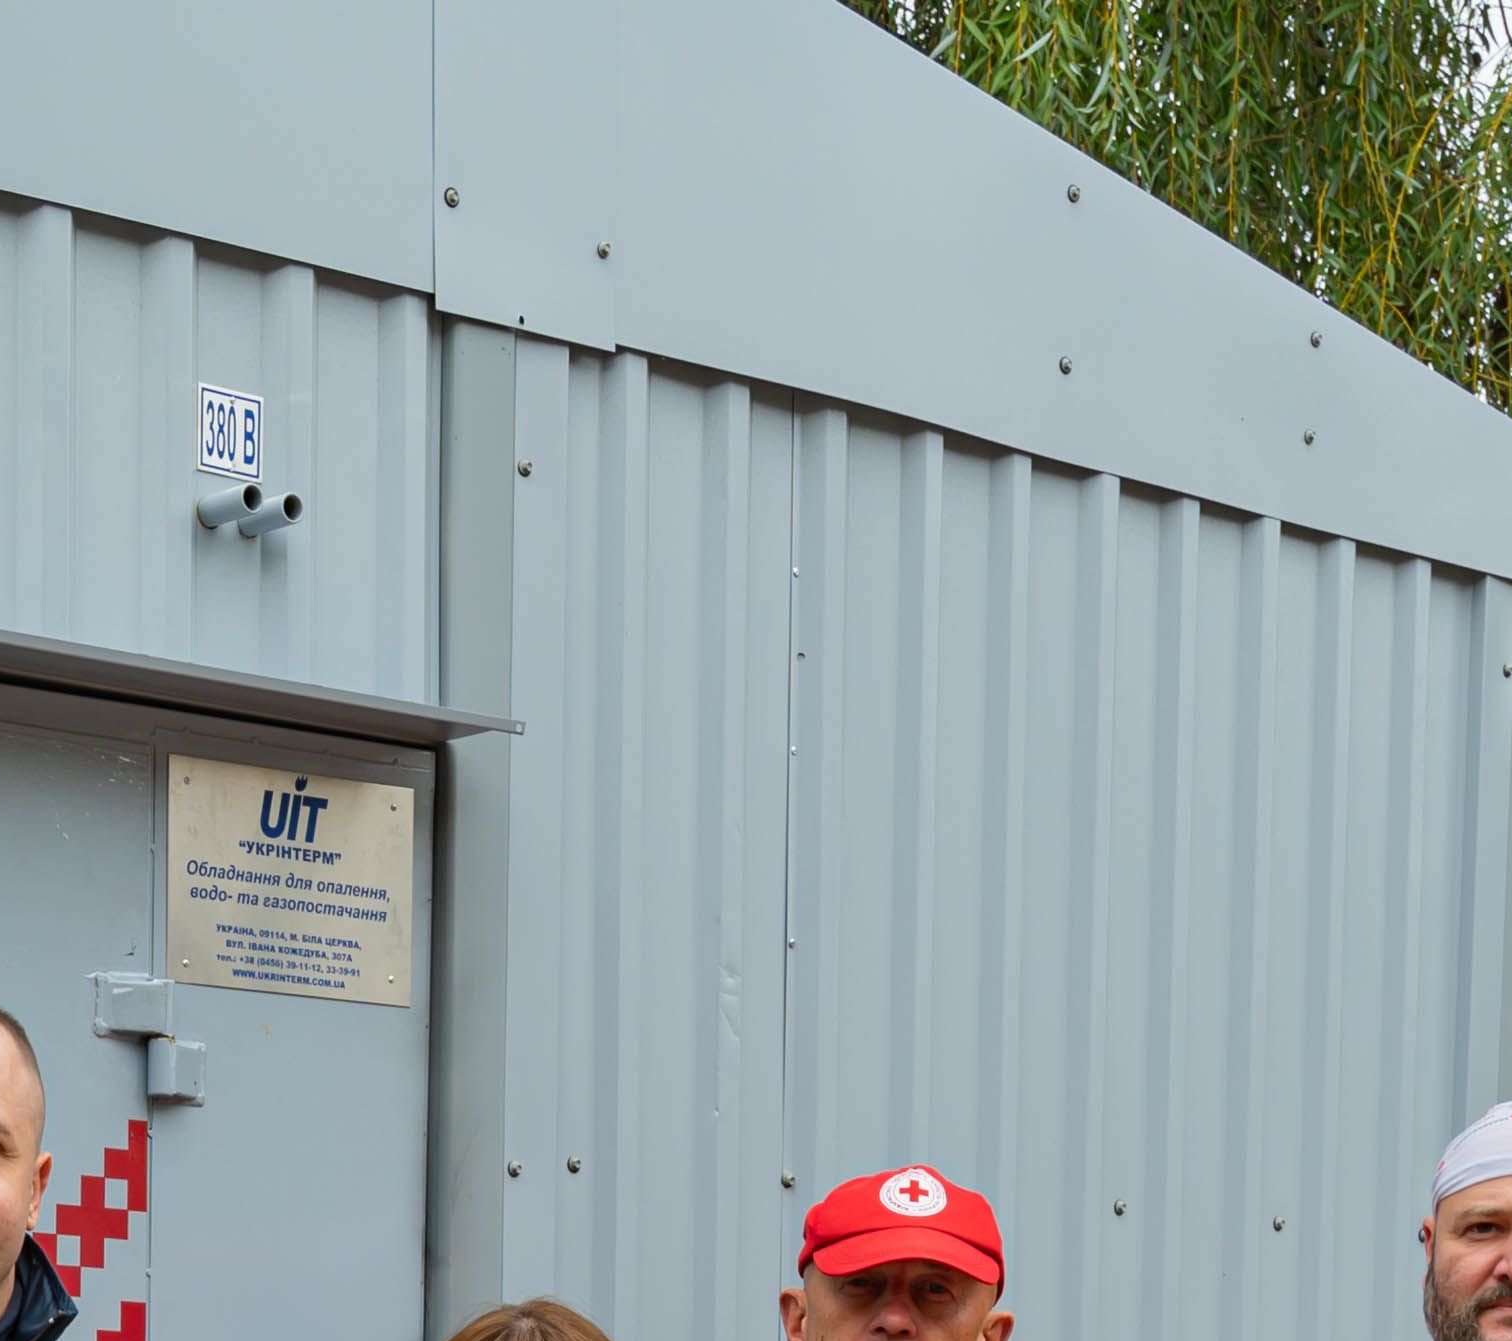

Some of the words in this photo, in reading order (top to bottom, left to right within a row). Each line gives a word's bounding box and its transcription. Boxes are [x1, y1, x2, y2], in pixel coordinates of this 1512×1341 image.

[206, 400, 237, 461] 380
[186, 860, 281, 887] Обладнання
[285, 872, 312, 891] для
[317, 880, 390, 902] опалення,
[190, 885, 233, 902] водо-
[237, 894, 259, 906] та
[263, 896, 388, 923] газопостачання
[248, 943, 276, 953] ІВАНА
[302, 934, 323, 944] БІЛА
[325, 938, 362, 950] ЦЕРКВА,
